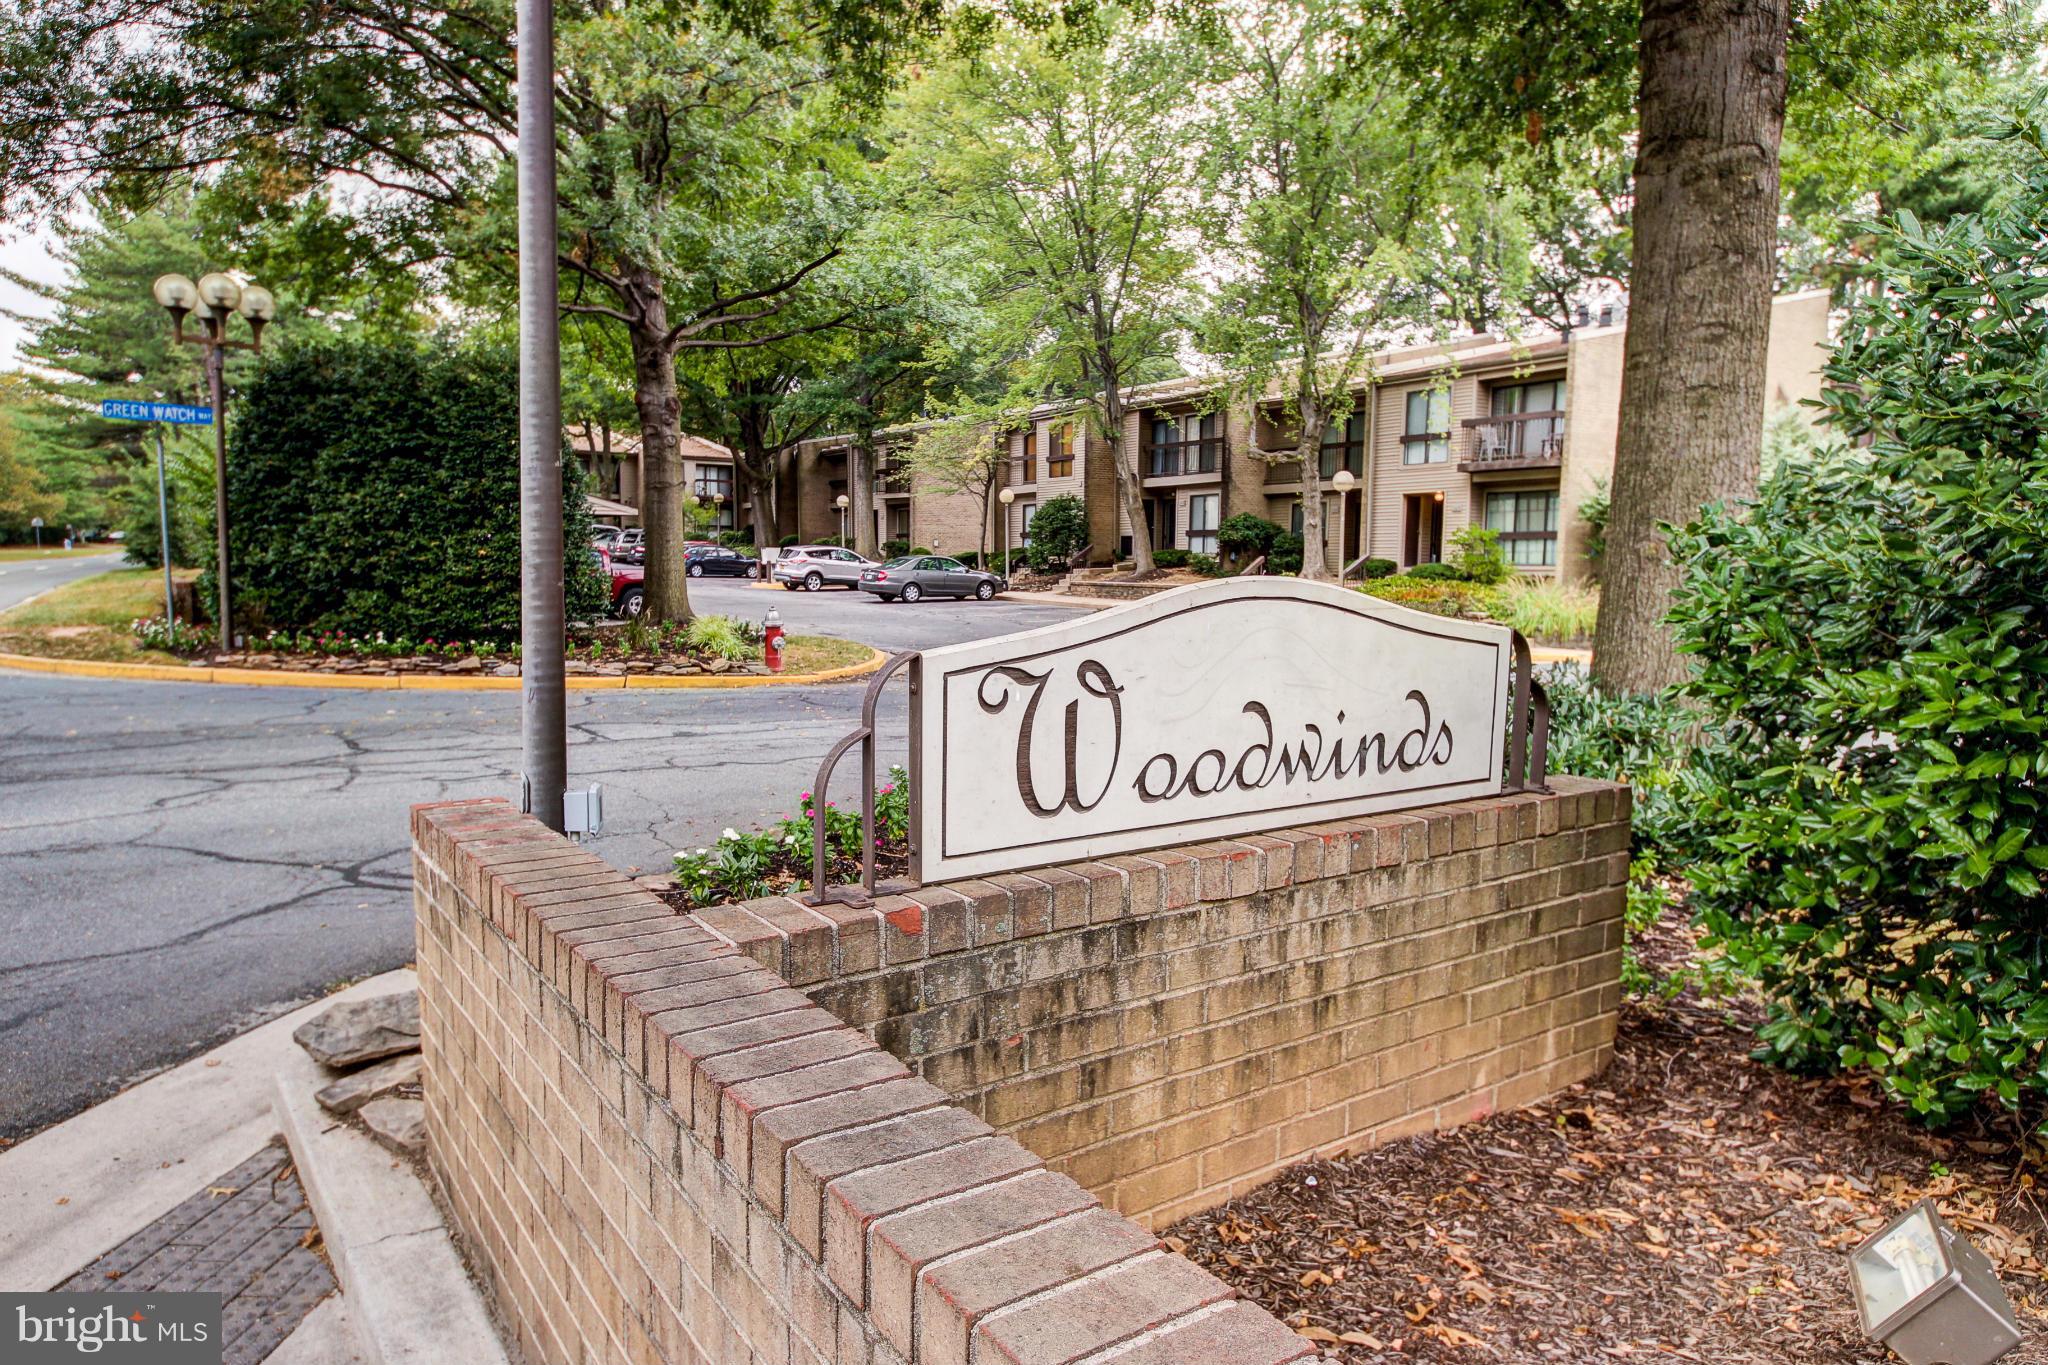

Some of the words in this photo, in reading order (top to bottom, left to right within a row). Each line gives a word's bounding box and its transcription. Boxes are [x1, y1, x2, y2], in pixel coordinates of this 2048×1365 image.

[104, 402, 149, 417] GREEN
[152, 406, 196, 421] WATCH
[977, 659, 1454, 817] Woodwinds
